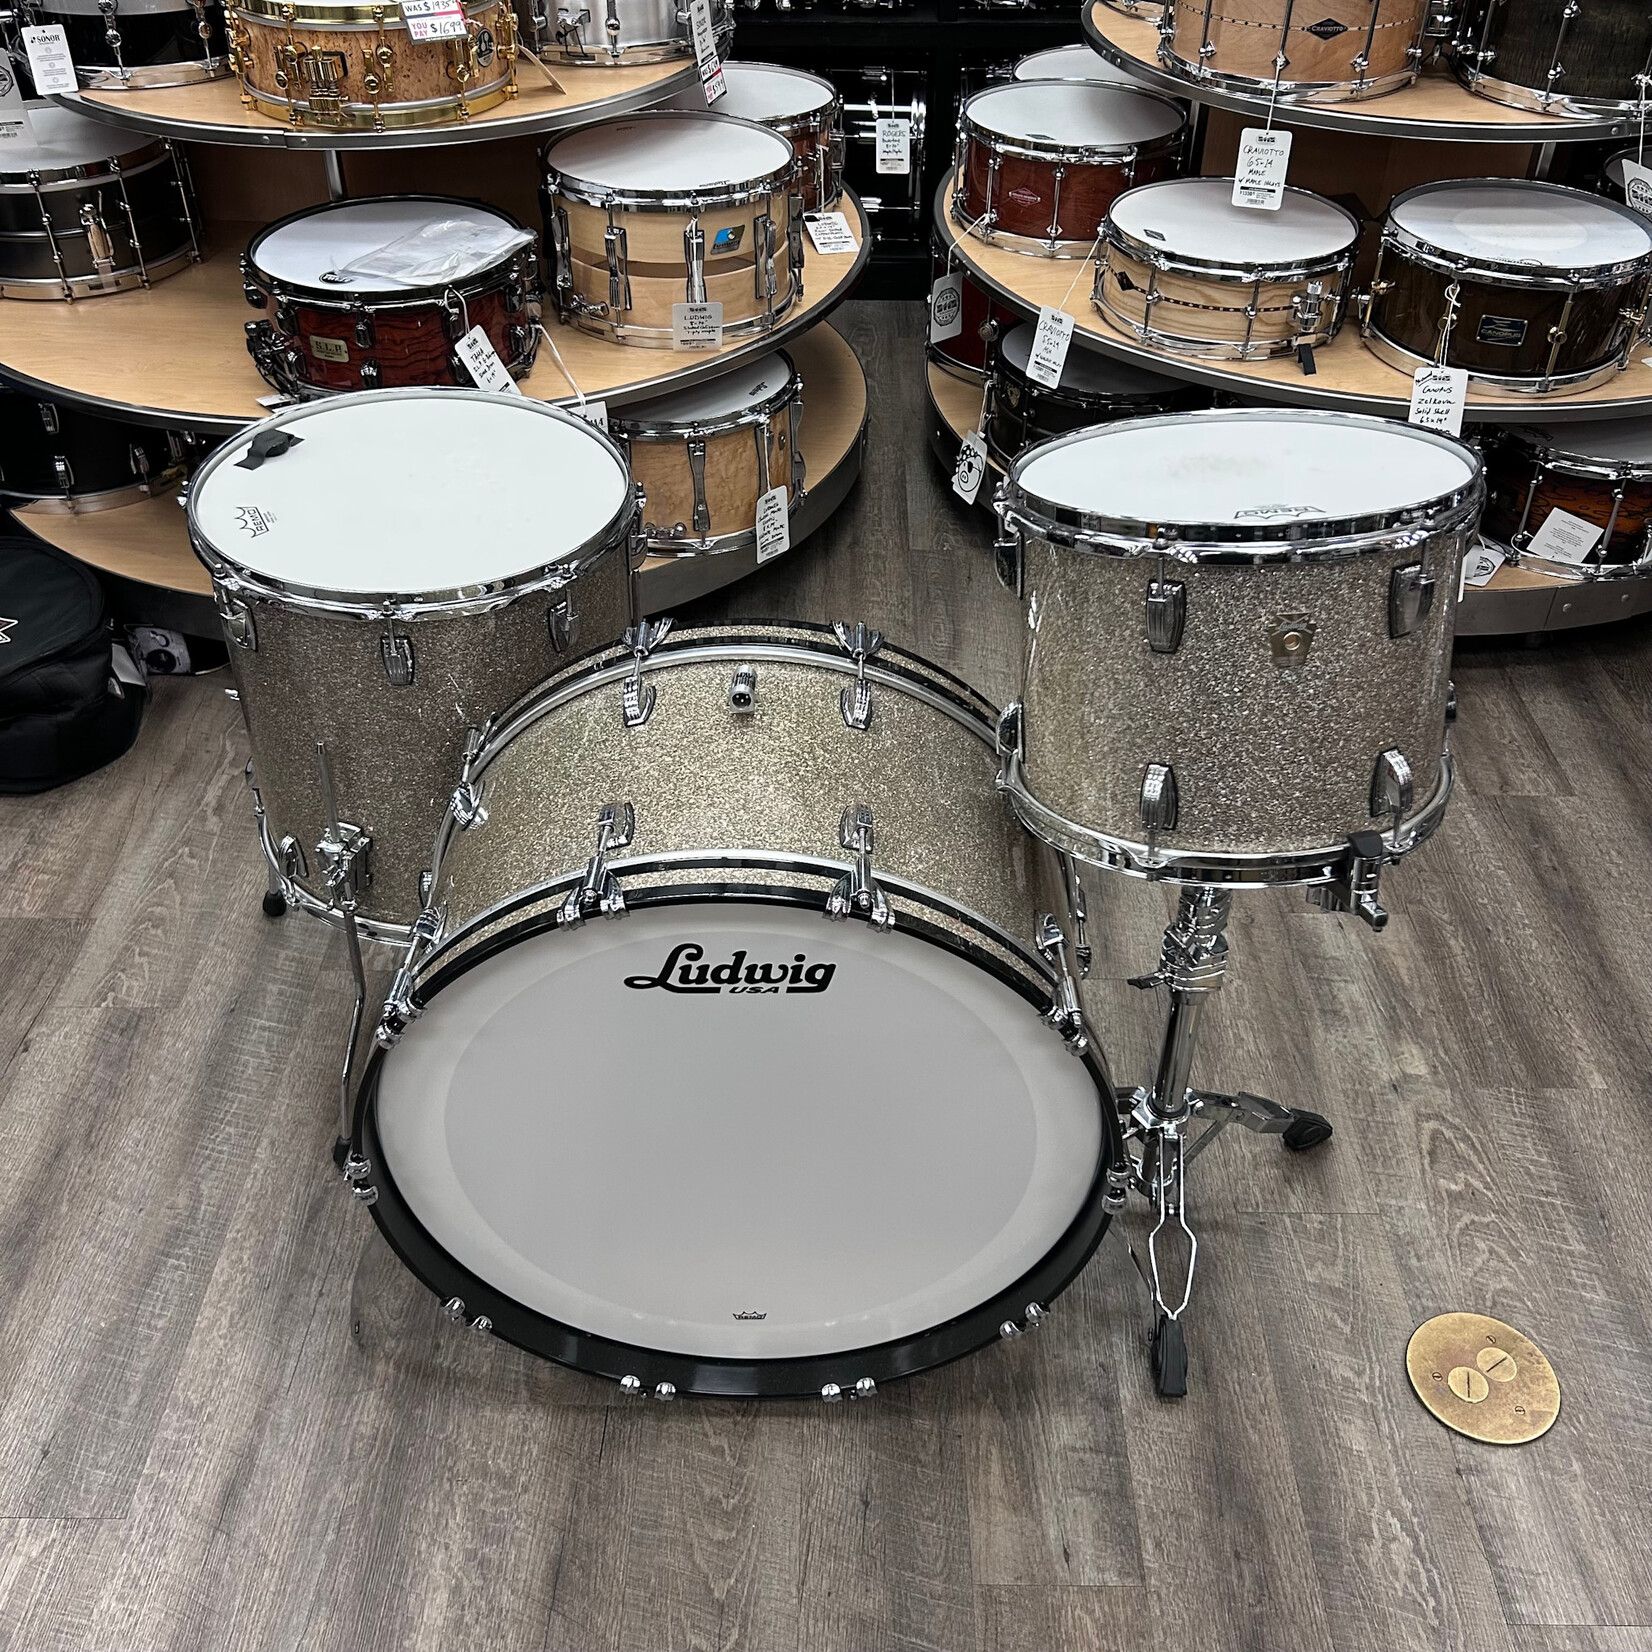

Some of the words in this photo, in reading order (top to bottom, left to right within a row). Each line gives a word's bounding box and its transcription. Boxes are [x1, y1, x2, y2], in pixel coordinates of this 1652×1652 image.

[405, 4, 422, 12] WAS
[411, 22, 428, 30] YOU
[36, 34, 60, 43] SONOR
[1242, 145, 1284, 156] CRAVIOTTO
[246, 509, 265, 532] REMO
[623, 942, 837, 994] Ludwig
[729, 986, 780, 994] USA
